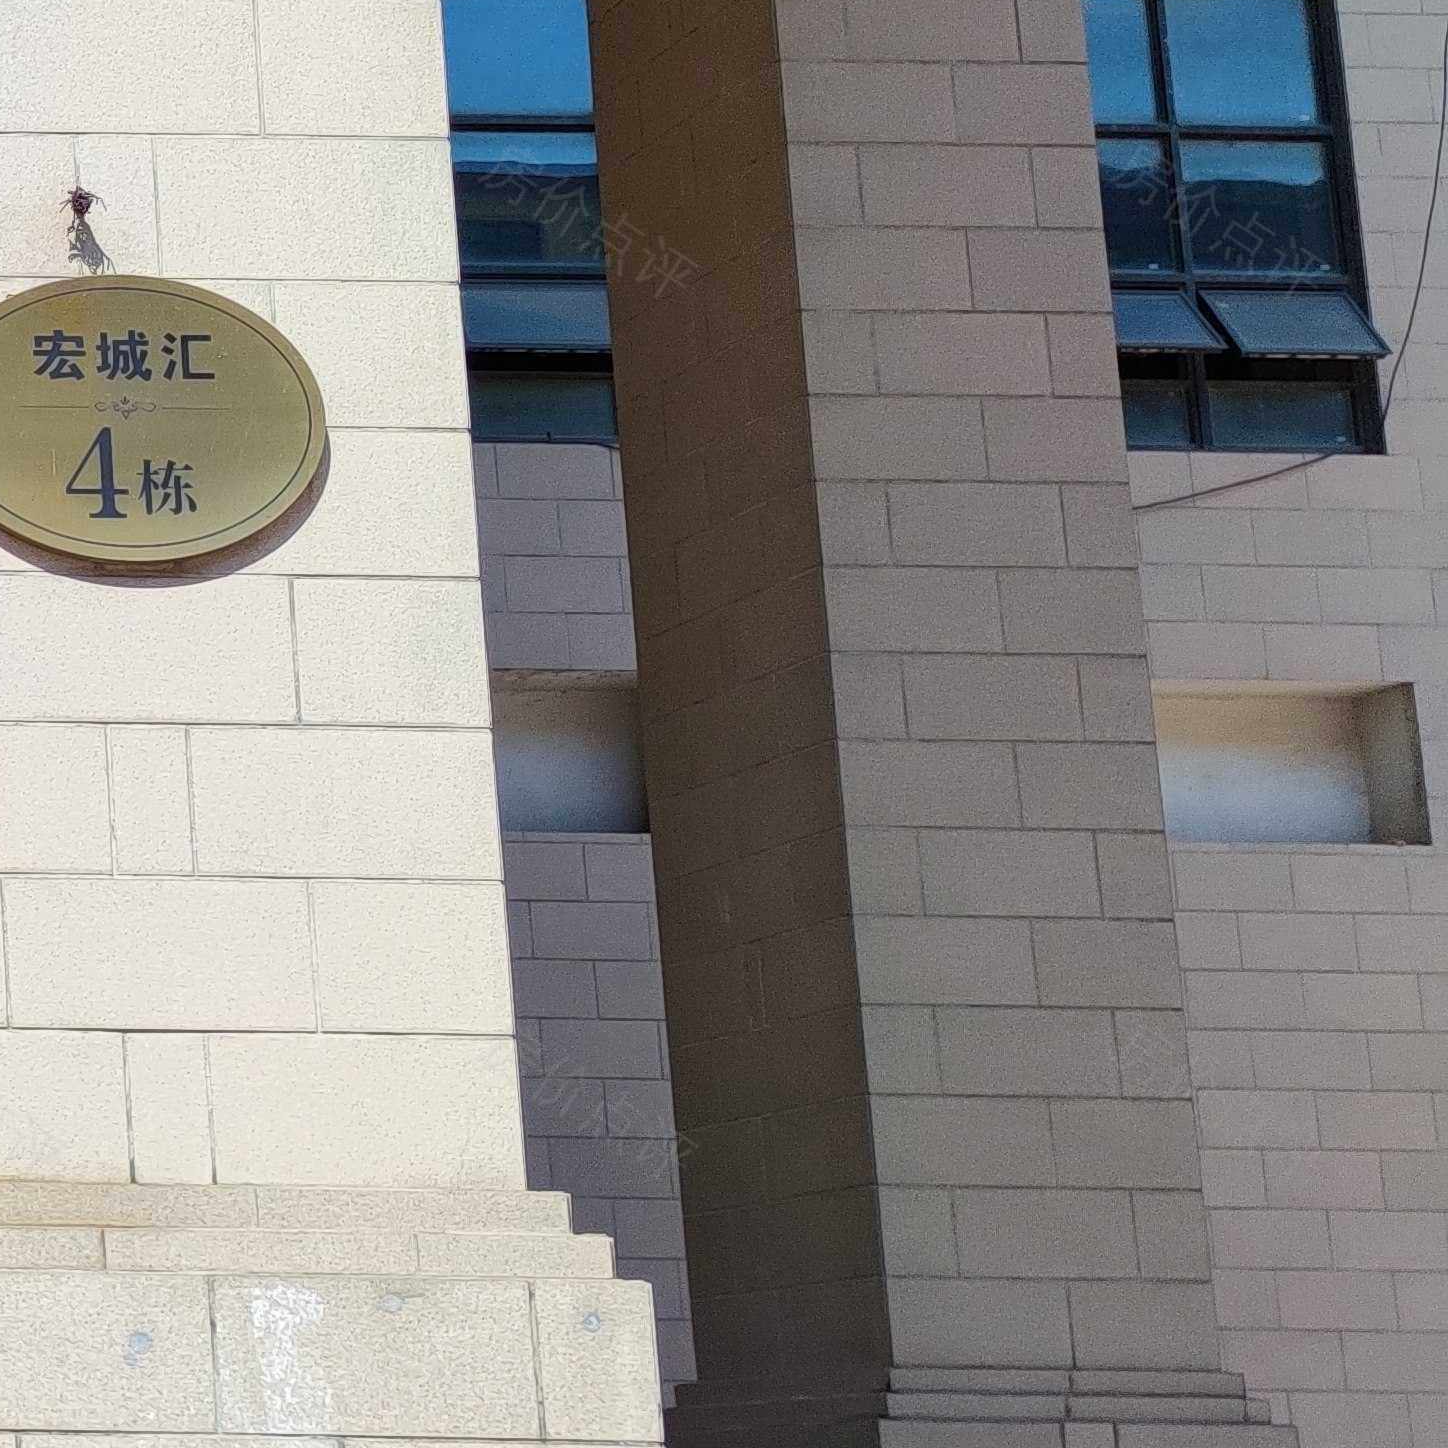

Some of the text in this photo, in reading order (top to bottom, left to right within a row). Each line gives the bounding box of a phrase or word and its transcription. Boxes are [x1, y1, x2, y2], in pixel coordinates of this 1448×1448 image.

[32, 329, 216, 382] 宏城汇
[65, 426, 198, 519] 4栋
